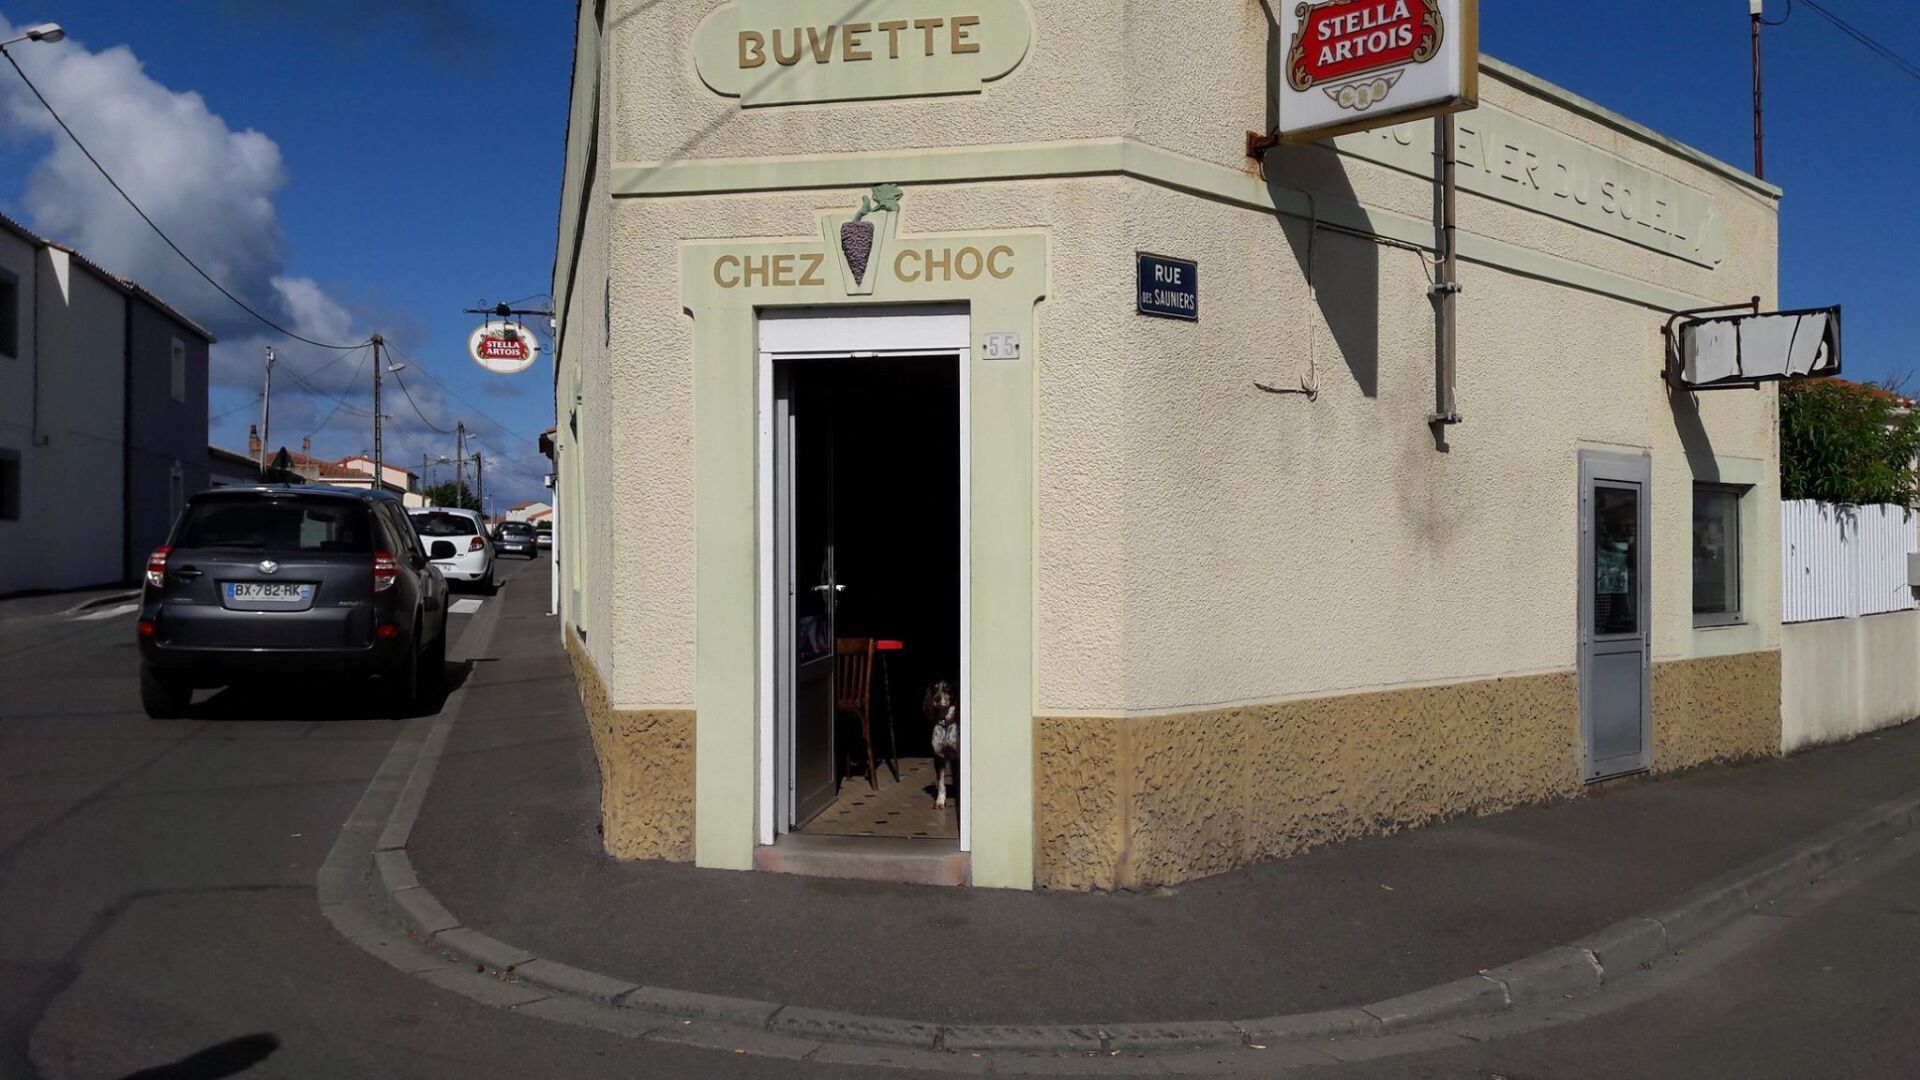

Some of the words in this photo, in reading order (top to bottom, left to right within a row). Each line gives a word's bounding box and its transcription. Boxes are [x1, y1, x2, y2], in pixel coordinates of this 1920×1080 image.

[1316, 0, 1411, 41] STELLA
[738, 15, 981, 69] BUVETTE
[1316, 23, 1413, 67] ARTOIS
[1431, 117, 1541, 191] EVER
[1600, 179, 1688, 241] SOLEIL
[713, 253, 825, 289] CHEZ
[893, 245, 1015, 283] CHOC
[1155, 264, 1181, 285] RUE
[1142, 291, 1152, 304] DES
[1154, 288, 1195, 310] SAUNIERS
[486, 340, 520, 348] STELLA
[486, 348, 520, 356] ARTOIS
[990, 335, 1014, 356] 55
[235, 584, 300, 597] BX-782-RK
